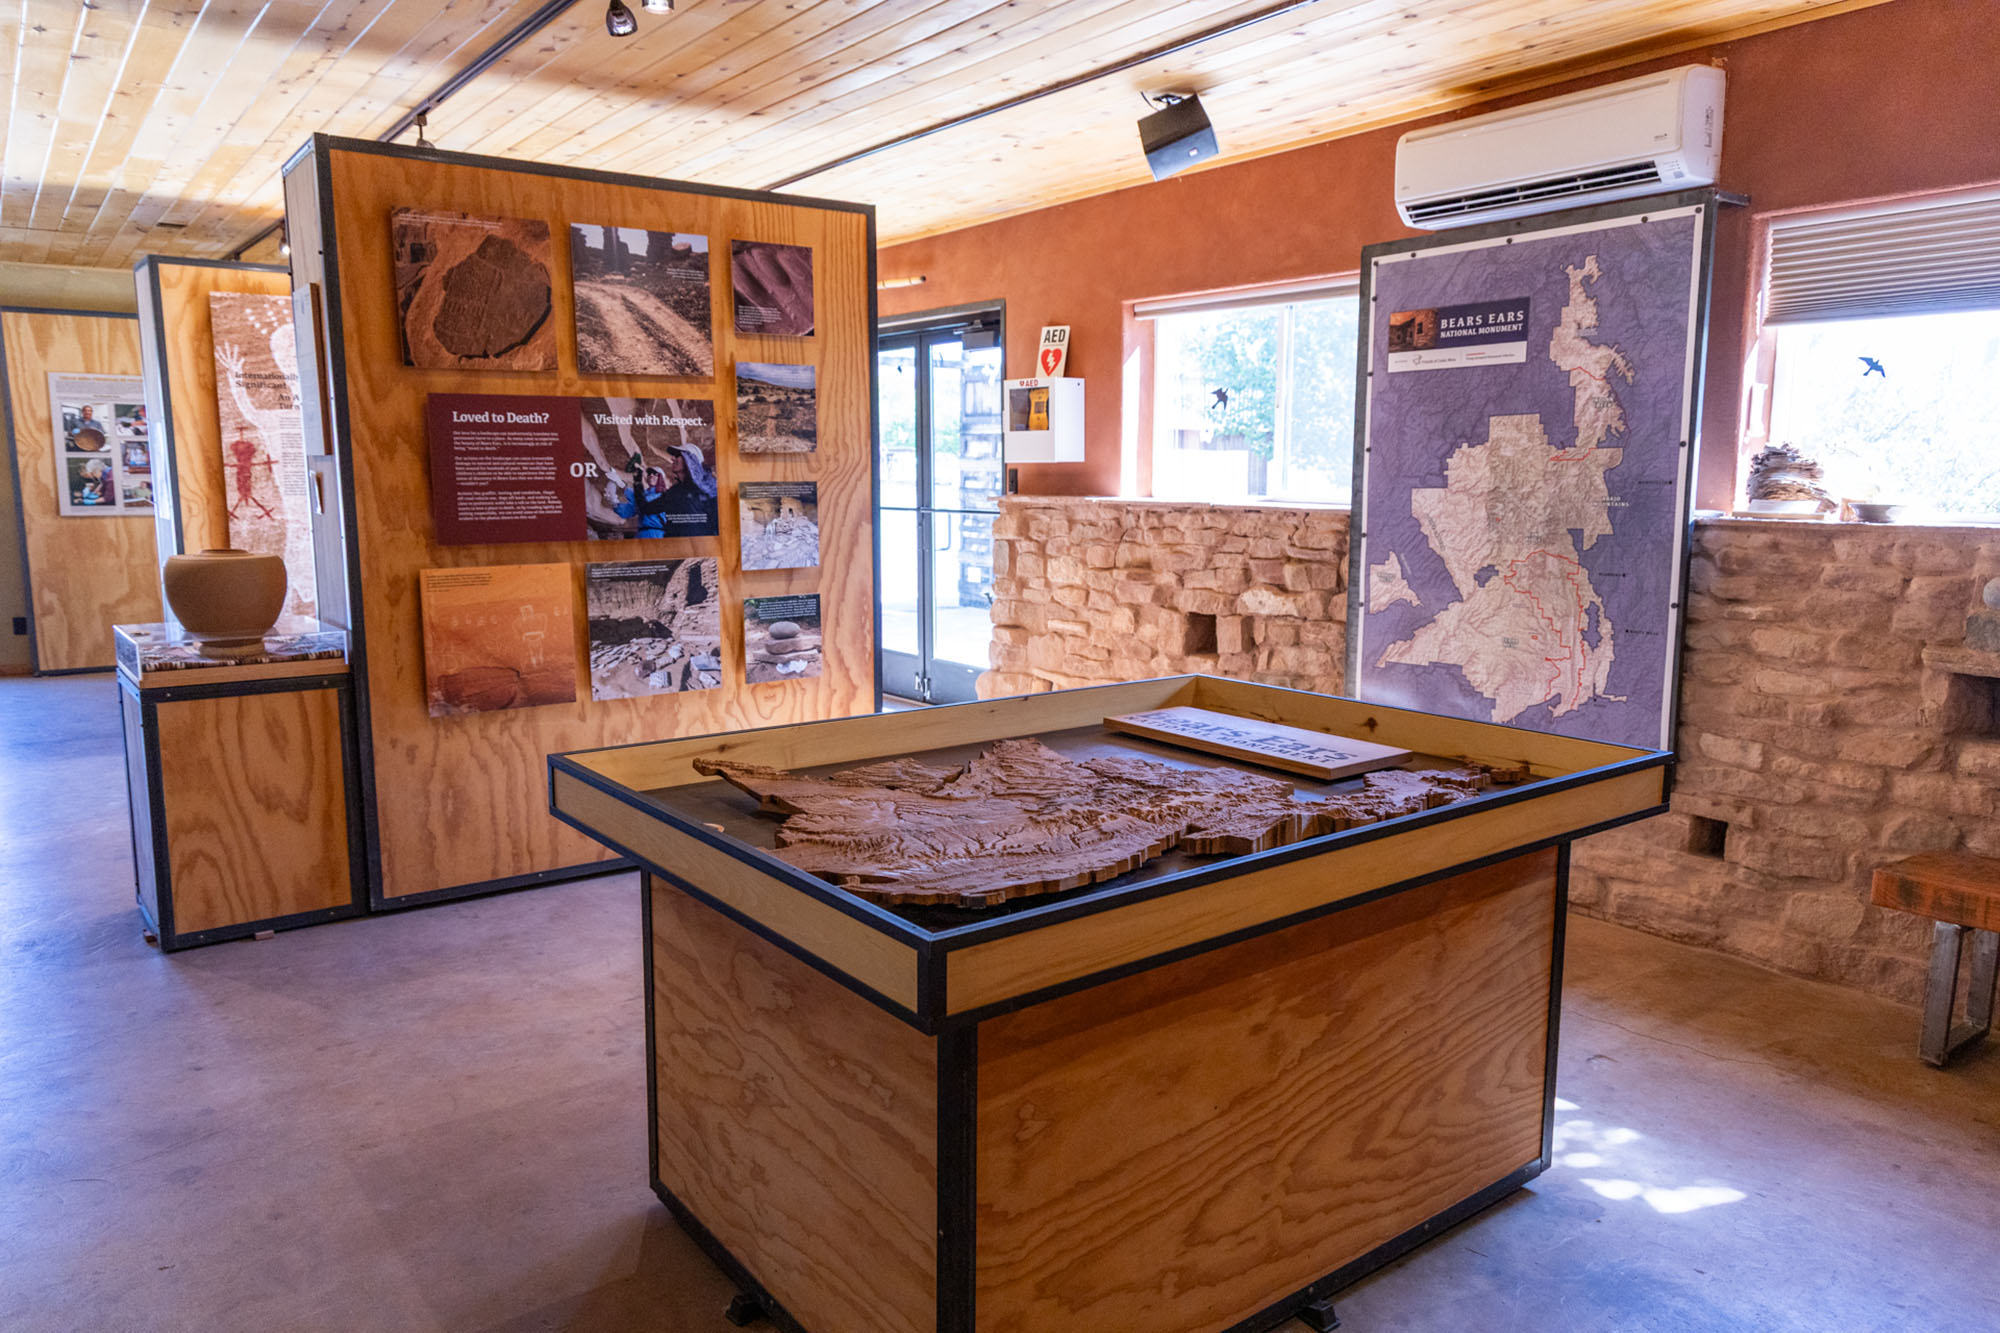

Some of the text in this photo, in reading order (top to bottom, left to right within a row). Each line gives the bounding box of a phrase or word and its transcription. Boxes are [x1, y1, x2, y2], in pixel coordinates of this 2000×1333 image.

[1440, 310, 1524, 329] BEARS EARS
[1043, 328, 1066, 343] AED
[1440, 323, 1523, 338] NATIONAL MONUMENT
[235, 380, 287, 390] Significant
[1025, 379, 1038, 387] AED
[452, 411, 550, 424] Loved to Death?
[593, 413, 707, 428] Visited with Respect.
[569, 462, 598, 478] OR
[1138, 712, 1359, 760] Bears Ears
